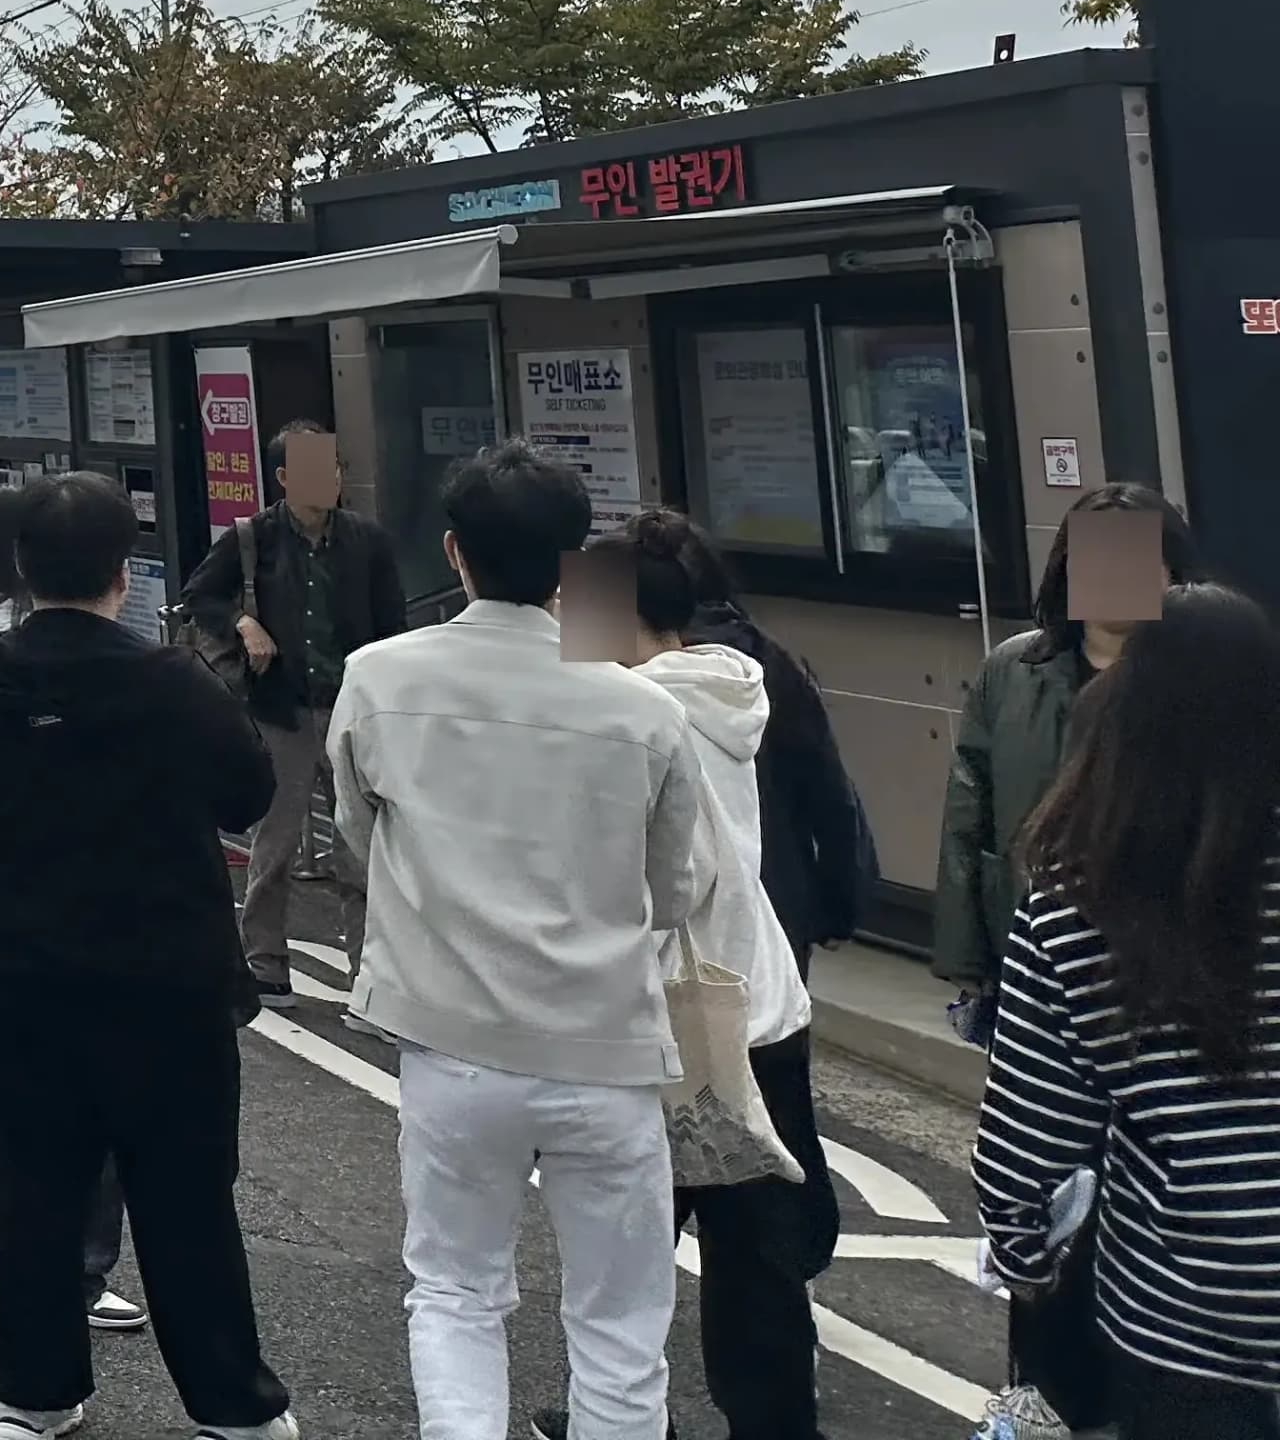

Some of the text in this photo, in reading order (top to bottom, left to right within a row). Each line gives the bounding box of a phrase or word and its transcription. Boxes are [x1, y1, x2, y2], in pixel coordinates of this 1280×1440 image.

[579, 144, 746, 220] 무인 발권기
[1240, 299, 1280, 334] 또
[527, 359, 623, 395] 무인매표소
[545, 398, 564, 411] SELF
